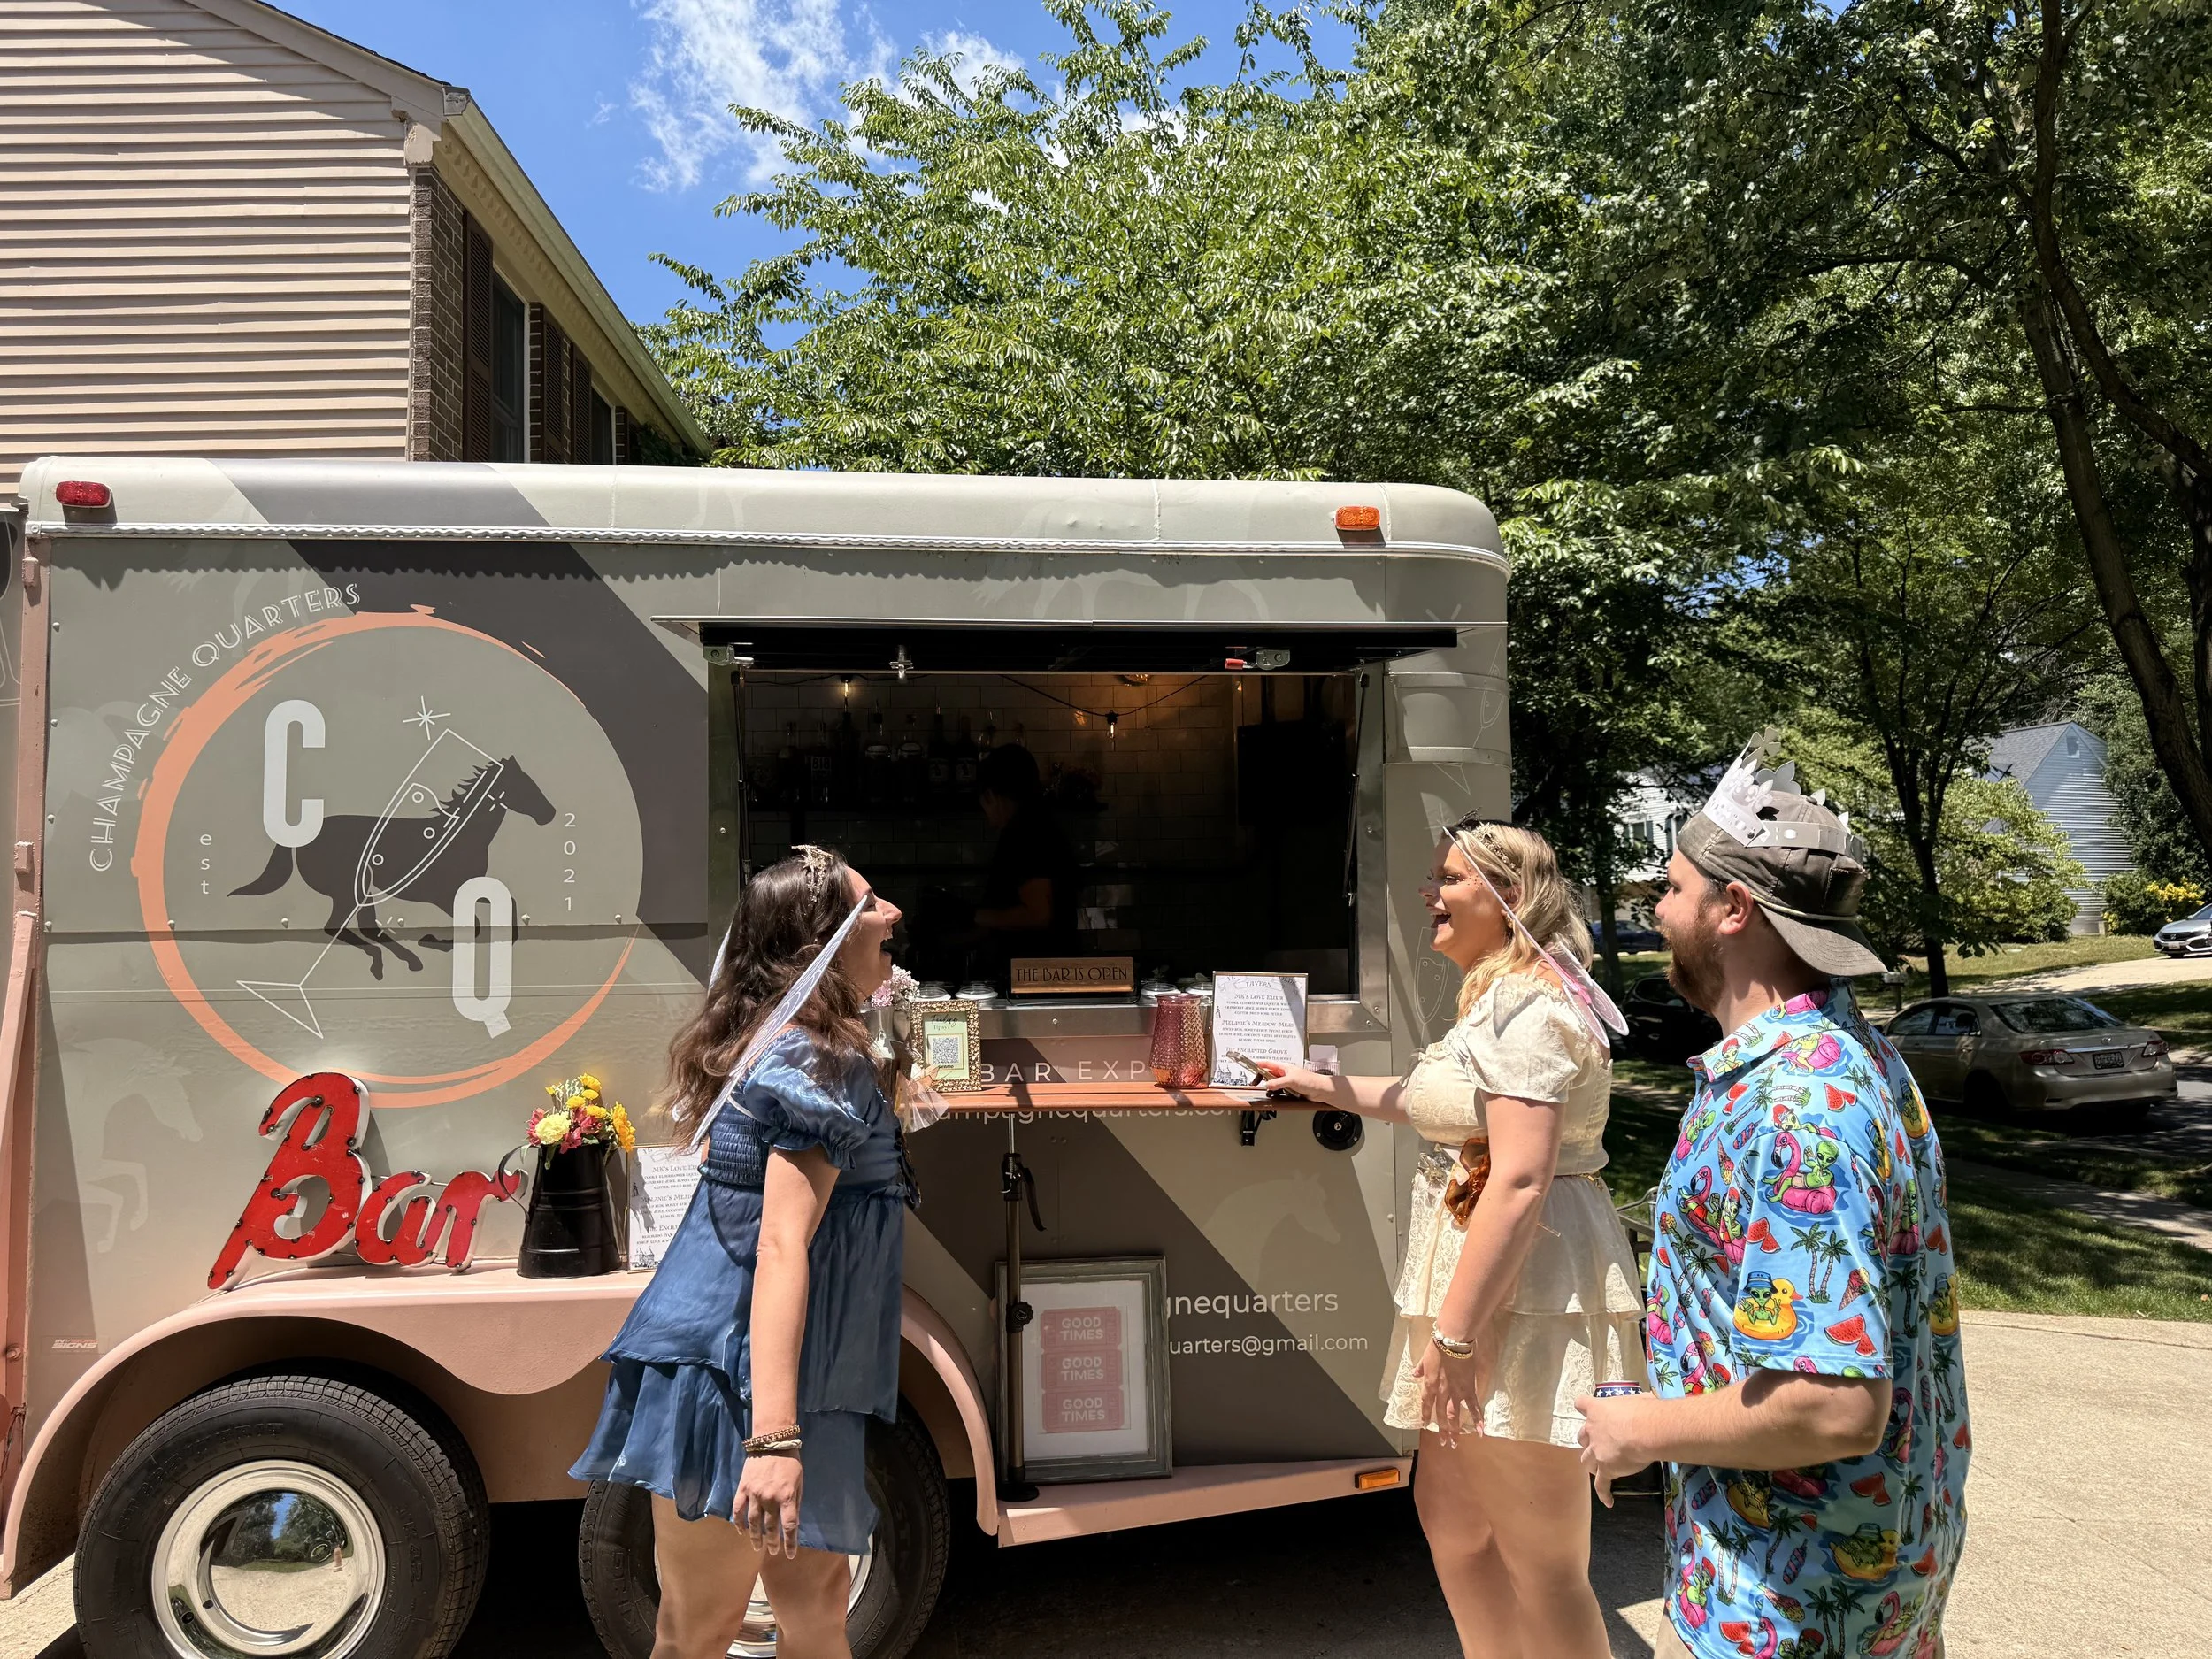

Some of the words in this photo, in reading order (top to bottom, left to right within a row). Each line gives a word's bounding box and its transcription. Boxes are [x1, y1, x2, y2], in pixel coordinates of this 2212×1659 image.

[89, 665, 193, 871] CHAMPAGNE
[192, 583, 360, 667] QUARTERS
[263, 699, 326, 848] C
[200, 833, 212, 895] est
[563, 812, 576, 911] 2021
[452, 876, 512, 1039] Q
[1018, 968, 1038, 982] THE
[1043, 967, 1070, 981] BAR
[1075, 967, 1084, 981] IS
[1087, 966, 1127, 980] OPEN
[980, 1062, 1052, 1082] BAR
[1078, 1060, 1146, 1080] EXP
[207, 1071, 529, 1291] Bar
[1062, 1317, 1102, 1329] GOOD
[1060, 1328, 1104, 1341] TIMES
[1169, 1333, 1368, 1356] uarters@gmail.com
[1062, 1356, 1102, 1370] GOOD
[1061, 1369, 1104, 1381] TIMES
[1063, 1397, 1103, 1409] GOOD
[1061, 1409, 1105, 1422] TIMES
